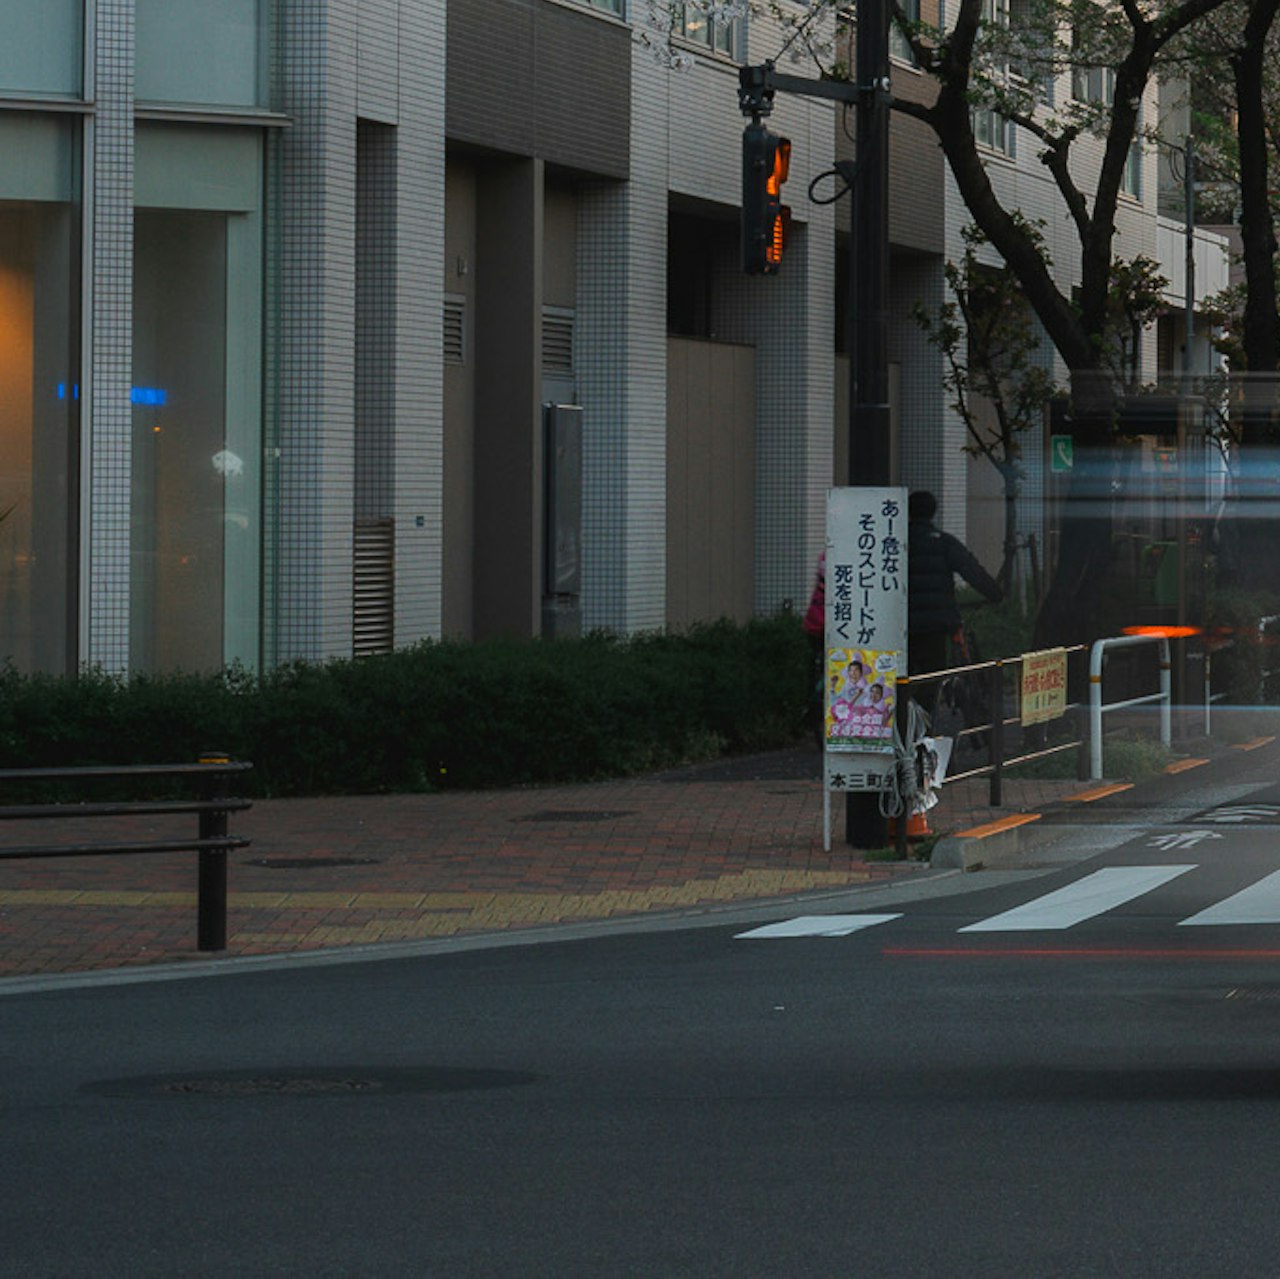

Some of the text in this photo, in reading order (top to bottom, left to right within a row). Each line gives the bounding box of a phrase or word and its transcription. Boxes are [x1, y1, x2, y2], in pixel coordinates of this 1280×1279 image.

[834, 564, 853, 640] 死を招く
[857, 513, 876, 645] そのスピードが
